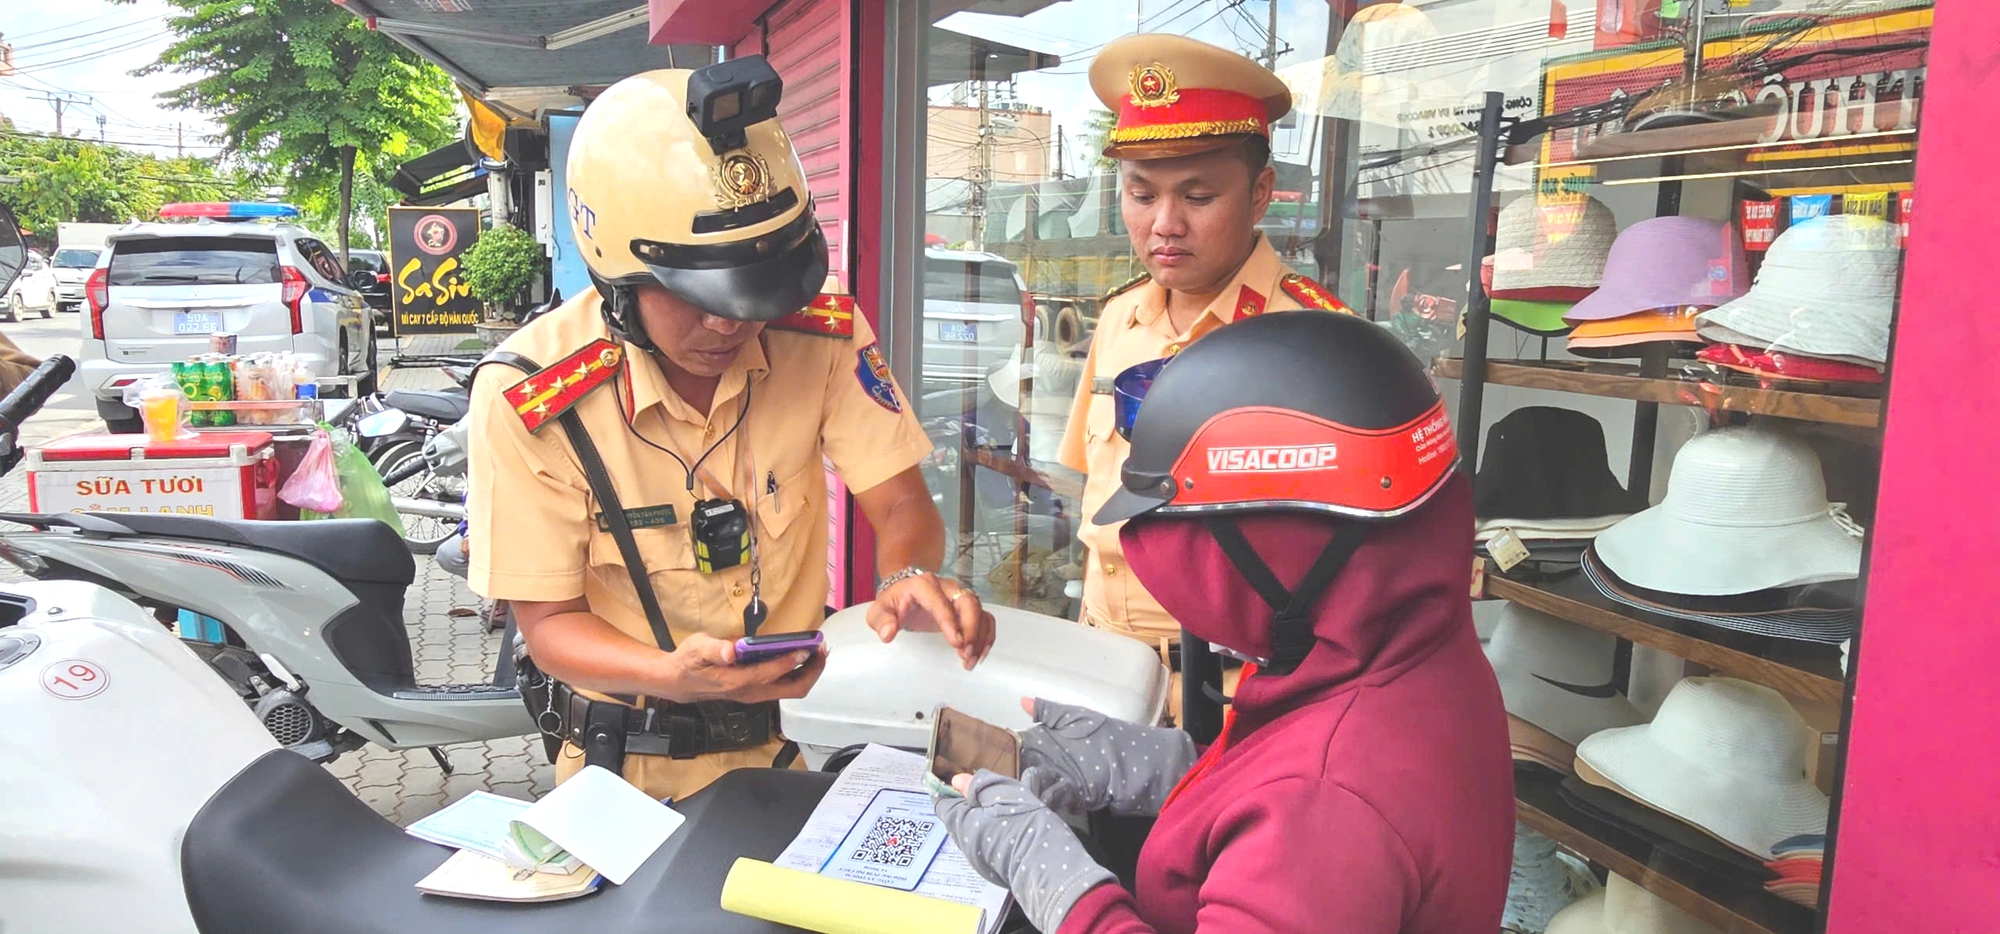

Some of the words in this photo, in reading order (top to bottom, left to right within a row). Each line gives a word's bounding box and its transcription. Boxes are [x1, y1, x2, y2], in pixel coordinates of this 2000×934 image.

[409, 313, 421, 325] CAY
[421, 313, 426, 325] 7
[426, 310, 439, 325] CẤP
[439, 311, 449, 327] ĐỘ
[449, 311, 462, 325] HÀN
[462, 310, 479, 324] QUỐC
[1207, 446, 1337, 471] VISACOOP
[76, 476, 131, 496] SỮA
[140, 475, 203, 494] TƯƠI
[53, 664, 97, 691] 19
